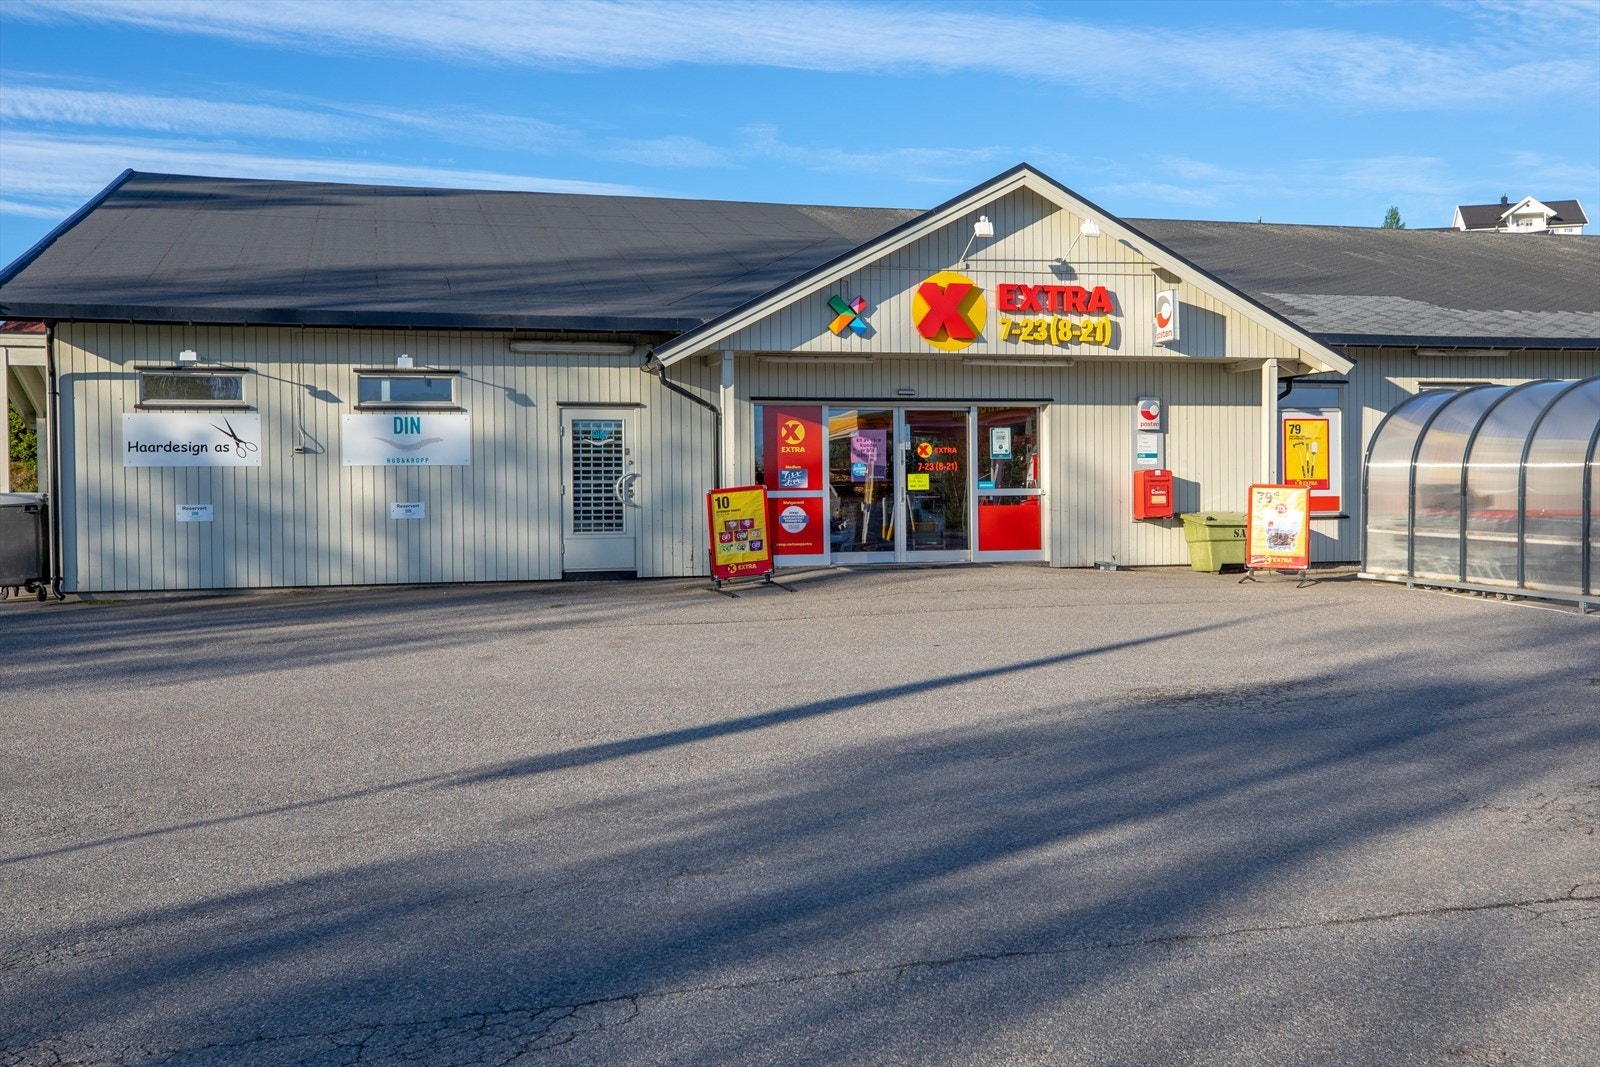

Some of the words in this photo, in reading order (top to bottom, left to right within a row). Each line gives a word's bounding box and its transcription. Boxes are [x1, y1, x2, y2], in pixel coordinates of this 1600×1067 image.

[998, 283, 1114, 313] EXTRA
[393, 416, 421, 435] DIN
[1289, 423, 1301, 434] 79
[127, 440, 208, 456] Haardesign
[214, 444, 230, 453] as
[917, 462, 934, 471] 7-23
[935, 461, 958, 472] (8-21)
[715, 496, 730, 509] 10
[1233, 528, 1247, 538] SA
[737, 563, 757, 571] EXTRA
